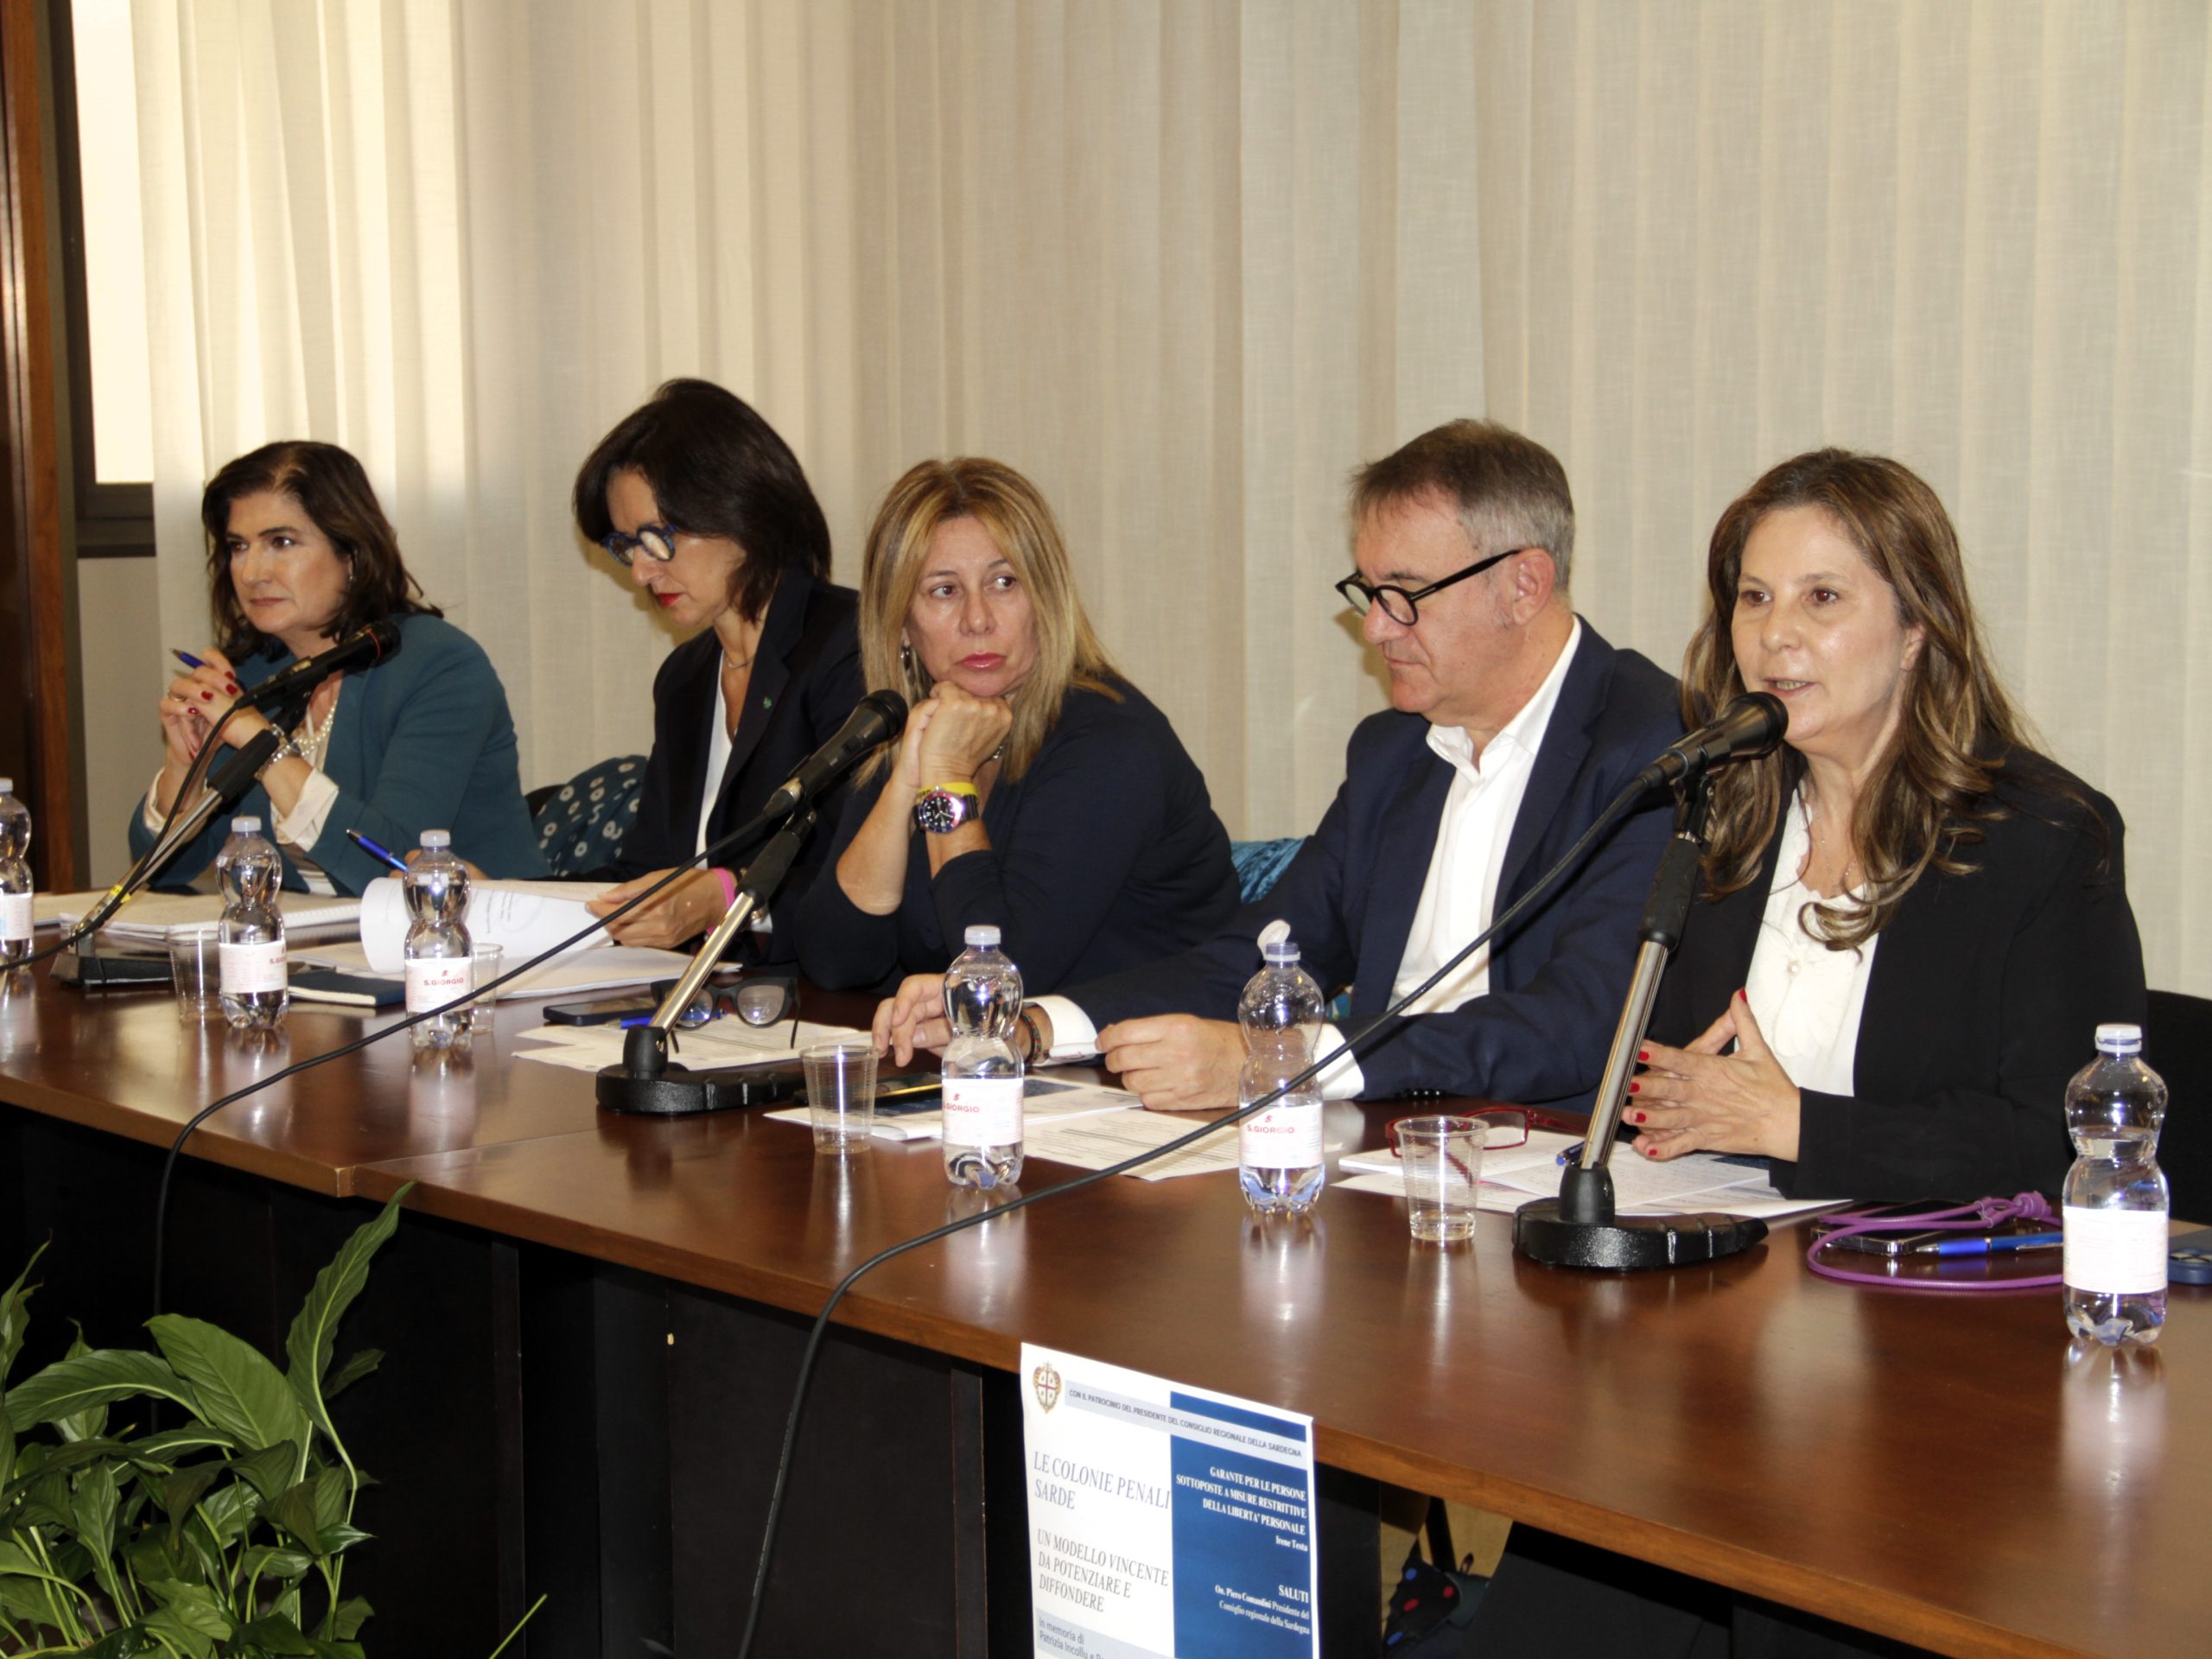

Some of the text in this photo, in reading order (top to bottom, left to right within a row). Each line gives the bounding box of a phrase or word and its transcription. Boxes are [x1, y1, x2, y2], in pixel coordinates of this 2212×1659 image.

[1247, 1124, 1294, 1134] S.GIORGIO
[1069, 1389, 1081, 1398] CON
[1088, 1395, 1121, 1409] PATROCINIO
[1122, 1403, 1132, 1413] DEL
[1133, 1407, 1166, 1422] PRESIDENTE
[1167, 1415, 1179, 1425] DEL
[1179, 1420, 1212, 1434] CONSIGLIO
[1213, 1427, 1247, 1444] REGIONALE
[1248, 1437, 1267, 1448] DELLA
[1268, 1442, 1301, 1458] SARDEGNA
[1033, 1451, 1170, 1510] LE COLONIE PENALI
[1034, 1478, 1076, 1510] SARDE
[1176, 1474, 1306, 1519] SOTTOPOSTE A MISURE RESTRITTIVE
[1210, 1466, 1306, 1501] GARANTE PER LE PERSONE
[1203, 1497, 1306, 1535] DELLA LIBERTA' PERSONALE
[1037, 1528, 1169, 1587] UN MODELLO VINCENTE
[1275, 1535, 1308, 1552] Irene Testa
[1038, 1551, 1132, 1599] DA POTENZIARE E
[1039, 1573, 1105, 1612] DIFFONDERE
[1278, 1584, 1309, 1604] SALUTI
[1039, 1617, 1084, 1645] In memoria di
[1039, 1630, 1064, 1650] Patrizia
